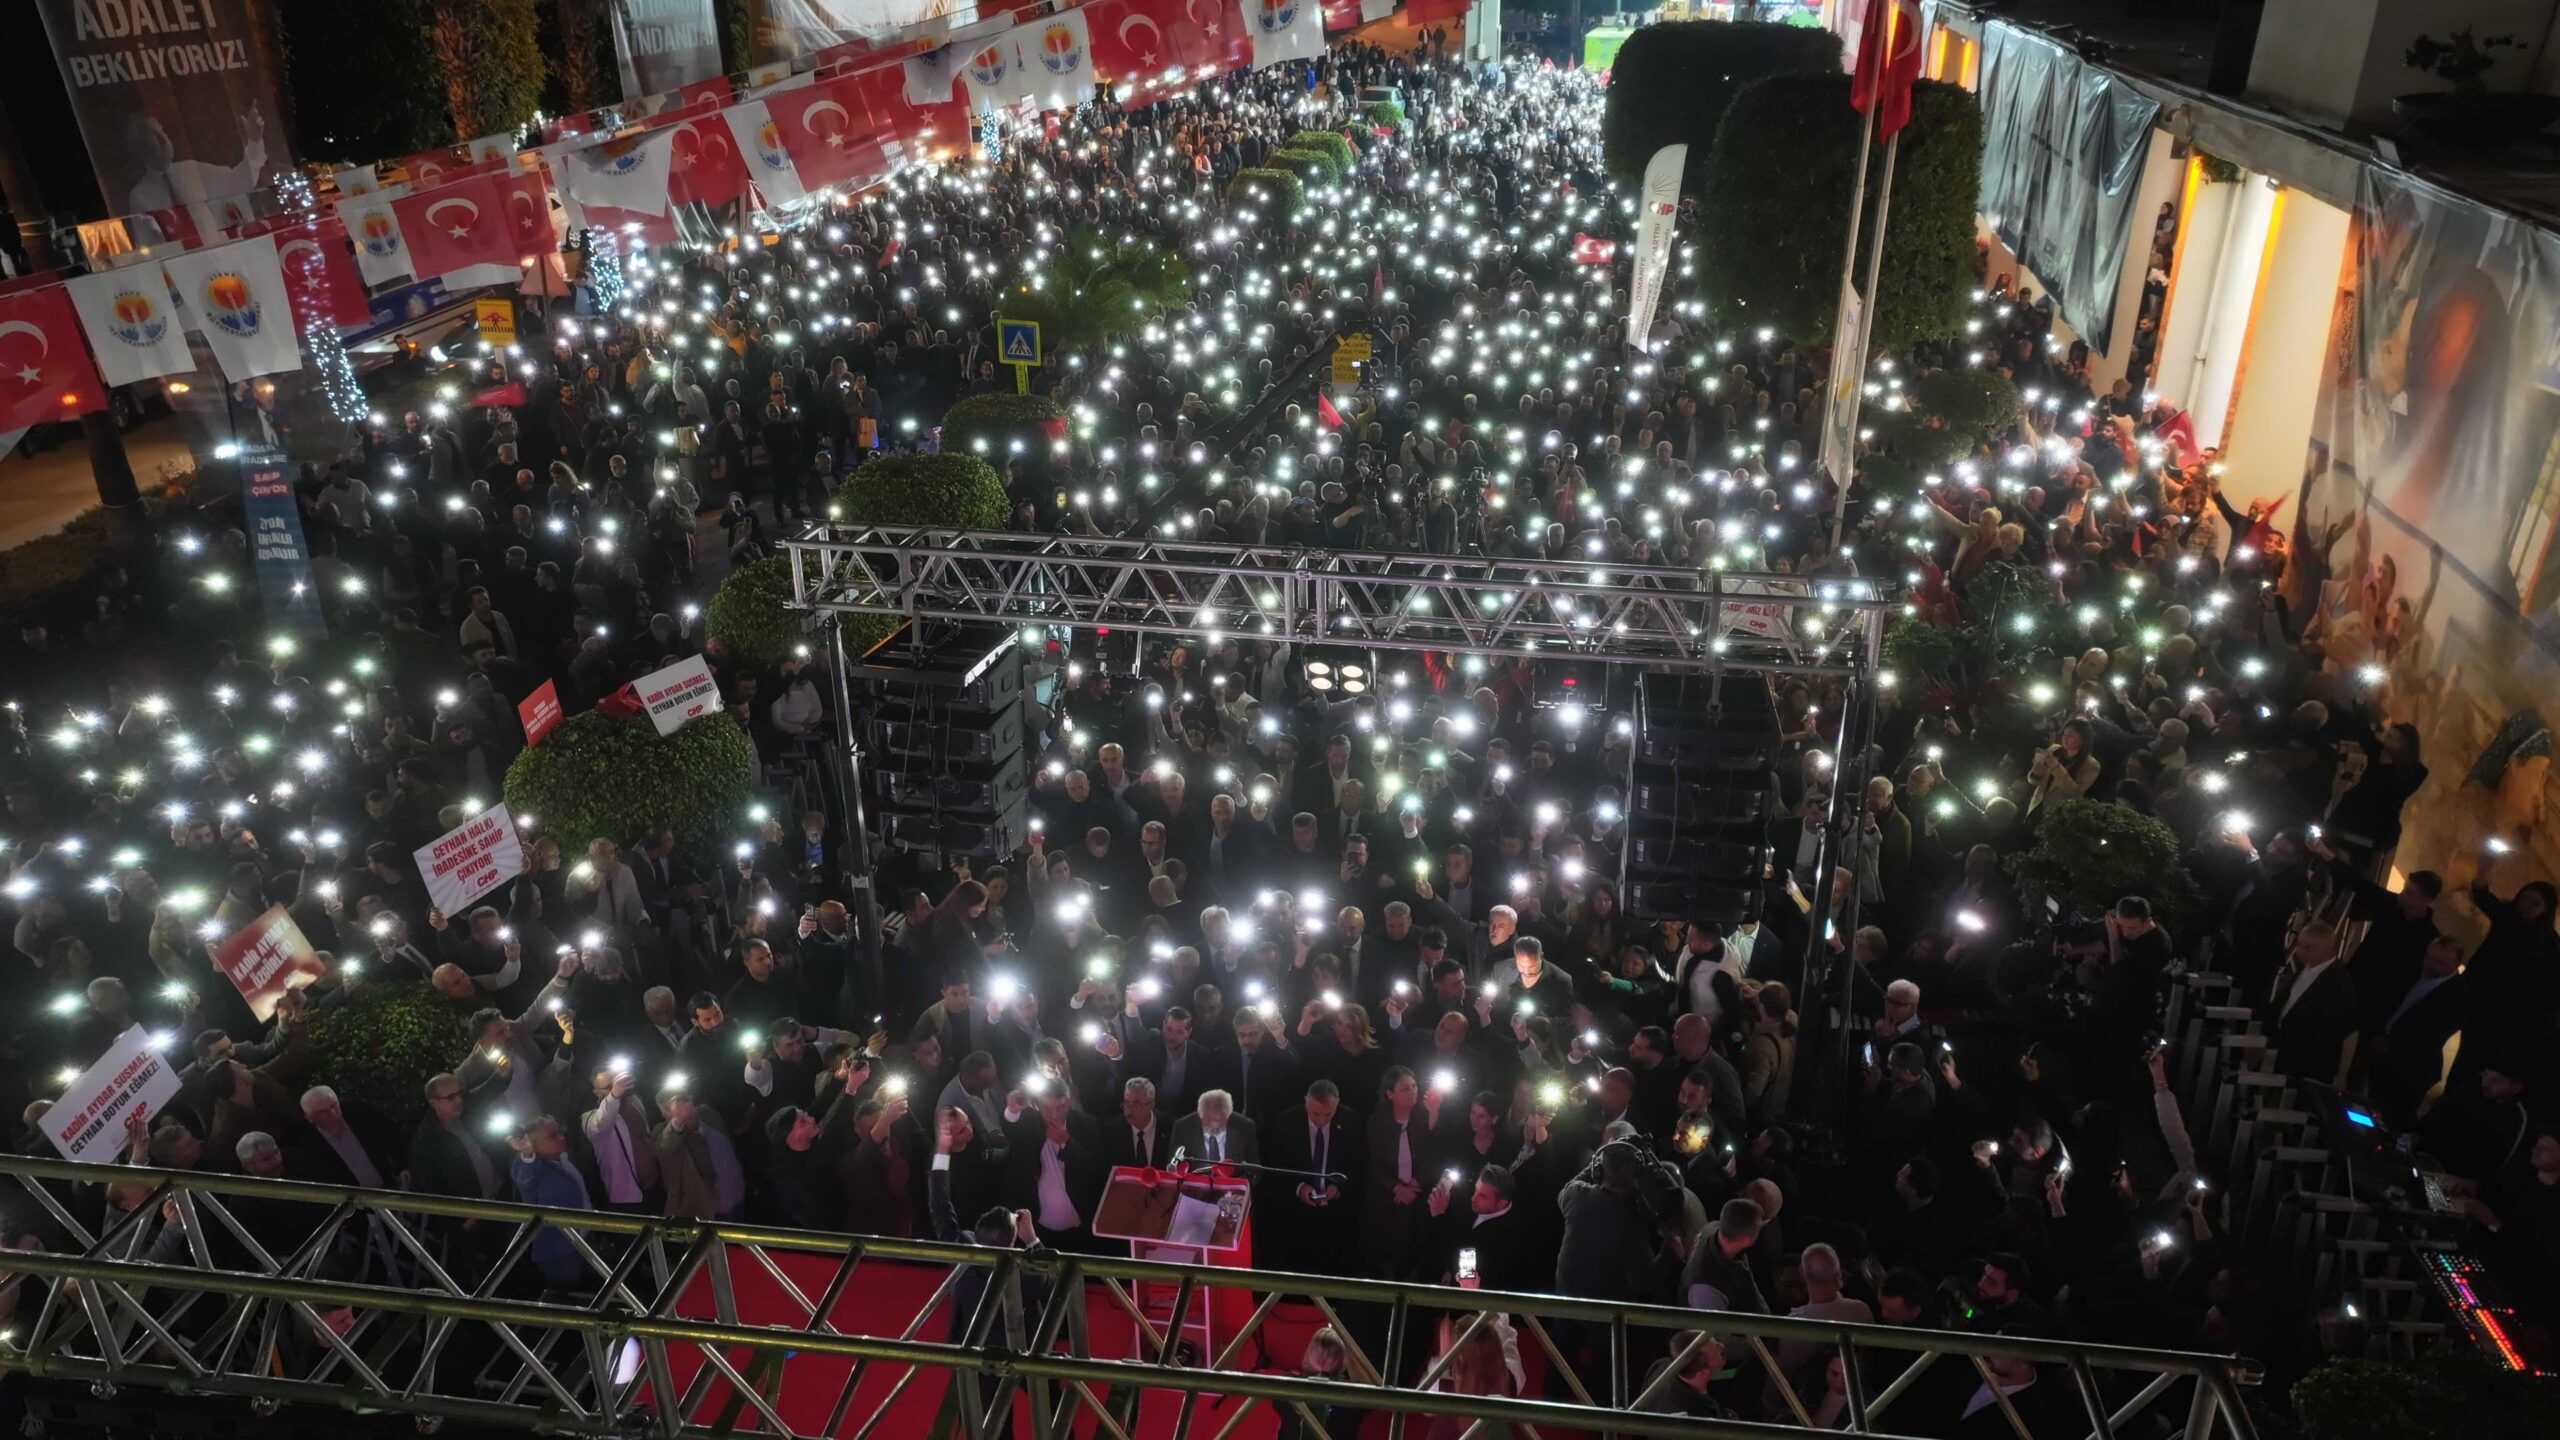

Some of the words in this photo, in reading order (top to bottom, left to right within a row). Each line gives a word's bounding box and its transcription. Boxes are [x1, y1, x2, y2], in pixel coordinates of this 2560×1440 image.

[69, 39, 249, 88] BEKLİYORUZ!
[646, 690, 665, 704] KADİR
[664, 682, 684, 697] AYDAR
[651, 700, 676, 715] CEYHAN
[673, 692, 694, 706] BOYUN
[687, 704, 704, 716] CHP
[432, 843, 479, 877] İRADESİNE
[479, 828, 504, 851] SAHİP
[433, 832, 468, 859] CEYHAN
[467, 817, 494, 839] HALKI
[456, 852, 494, 885] ÇIKIYOR!
[477, 868, 498, 887] CHP
[232, 949, 261, 982] KADİR
[61, 1113, 89, 1143] KADİR
[86, 1085, 116, 1117] AYDAR
[70, 1118, 104, 1155] CEYHAN
[102, 1090, 131, 1122] BOYUN
[129, 1060, 161, 1094] EĞMEZ!
[123, 1101, 148, 1130] CHP
